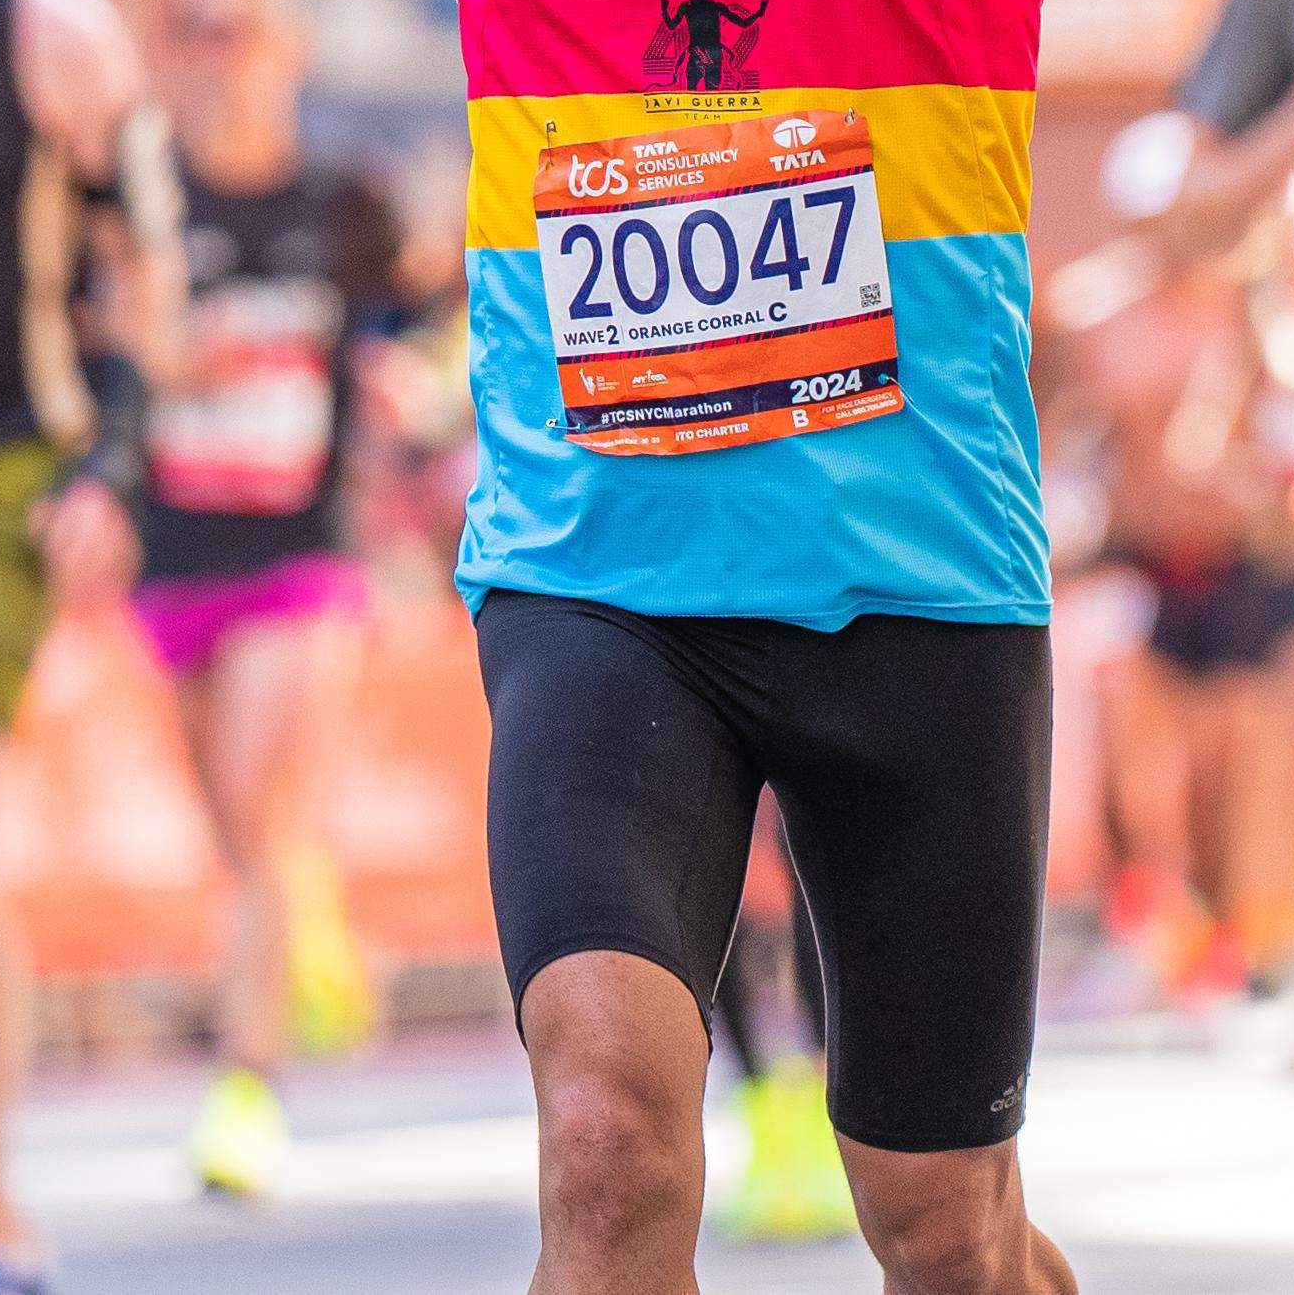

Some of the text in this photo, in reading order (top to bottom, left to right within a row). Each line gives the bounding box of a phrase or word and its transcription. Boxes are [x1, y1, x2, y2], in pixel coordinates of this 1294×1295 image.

[691, 96, 761, 107] GUERRA
[684, 113, 721, 121] TEAM
[632, 140, 679, 159] TATA
[634, 147, 739, 175] CONSULTANCY
[769, 149, 827, 173] TATA
[638, 169, 705, 192] SERVICES
[559, 185, 857, 321] 20047
[563, 301, 788, 347] WAVE 2 ORANGE CORRAL C
[789, 368, 863, 404] 2024
[601, 400, 733, 425] #TCSNYCMarathon
[791, 408, 810, 429] B
[696, 422, 750, 440] CHARTER
